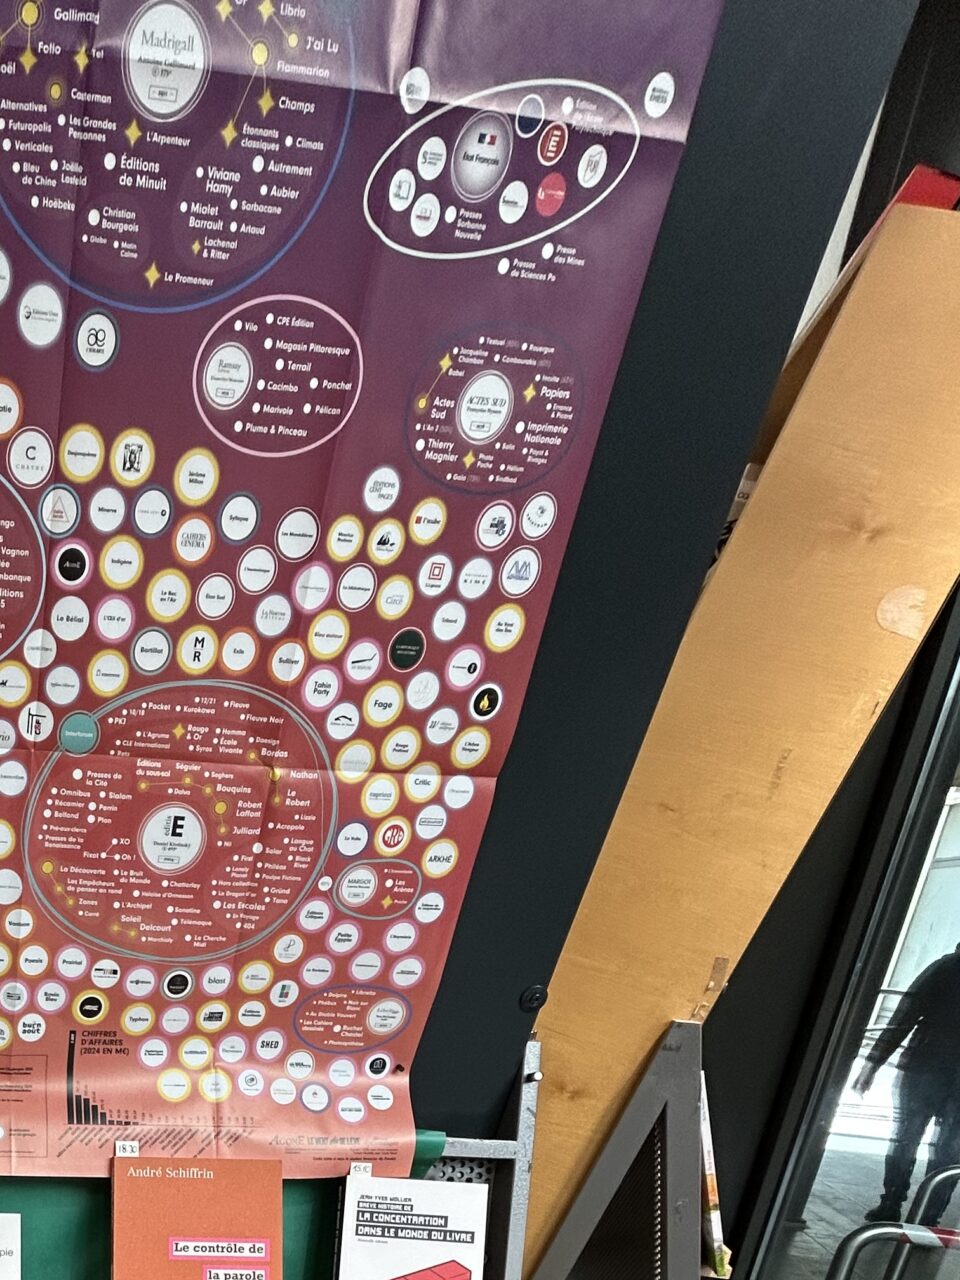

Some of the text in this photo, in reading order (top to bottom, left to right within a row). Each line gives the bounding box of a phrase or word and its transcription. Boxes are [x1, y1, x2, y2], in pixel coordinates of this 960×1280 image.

[54, 8, 100, 24] Gallimard
[141, 28, 195, 53] Madrigall
[120, 155, 160, 173] Éditions
[119, 174, 167, 191] de Minuit
[260, 1040, 279, 1049] SHED
[127, 1165, 214, 1180] André Schiffrin
[359, 1212, 445, 1227] LA CONCENTRATION
[357, 1225, 473, 1242] DANS LE MONDE DU LIVRE
[174, 1241, 264, 1254] Le contrôle de
[208, 1270, 219, 1280] la
